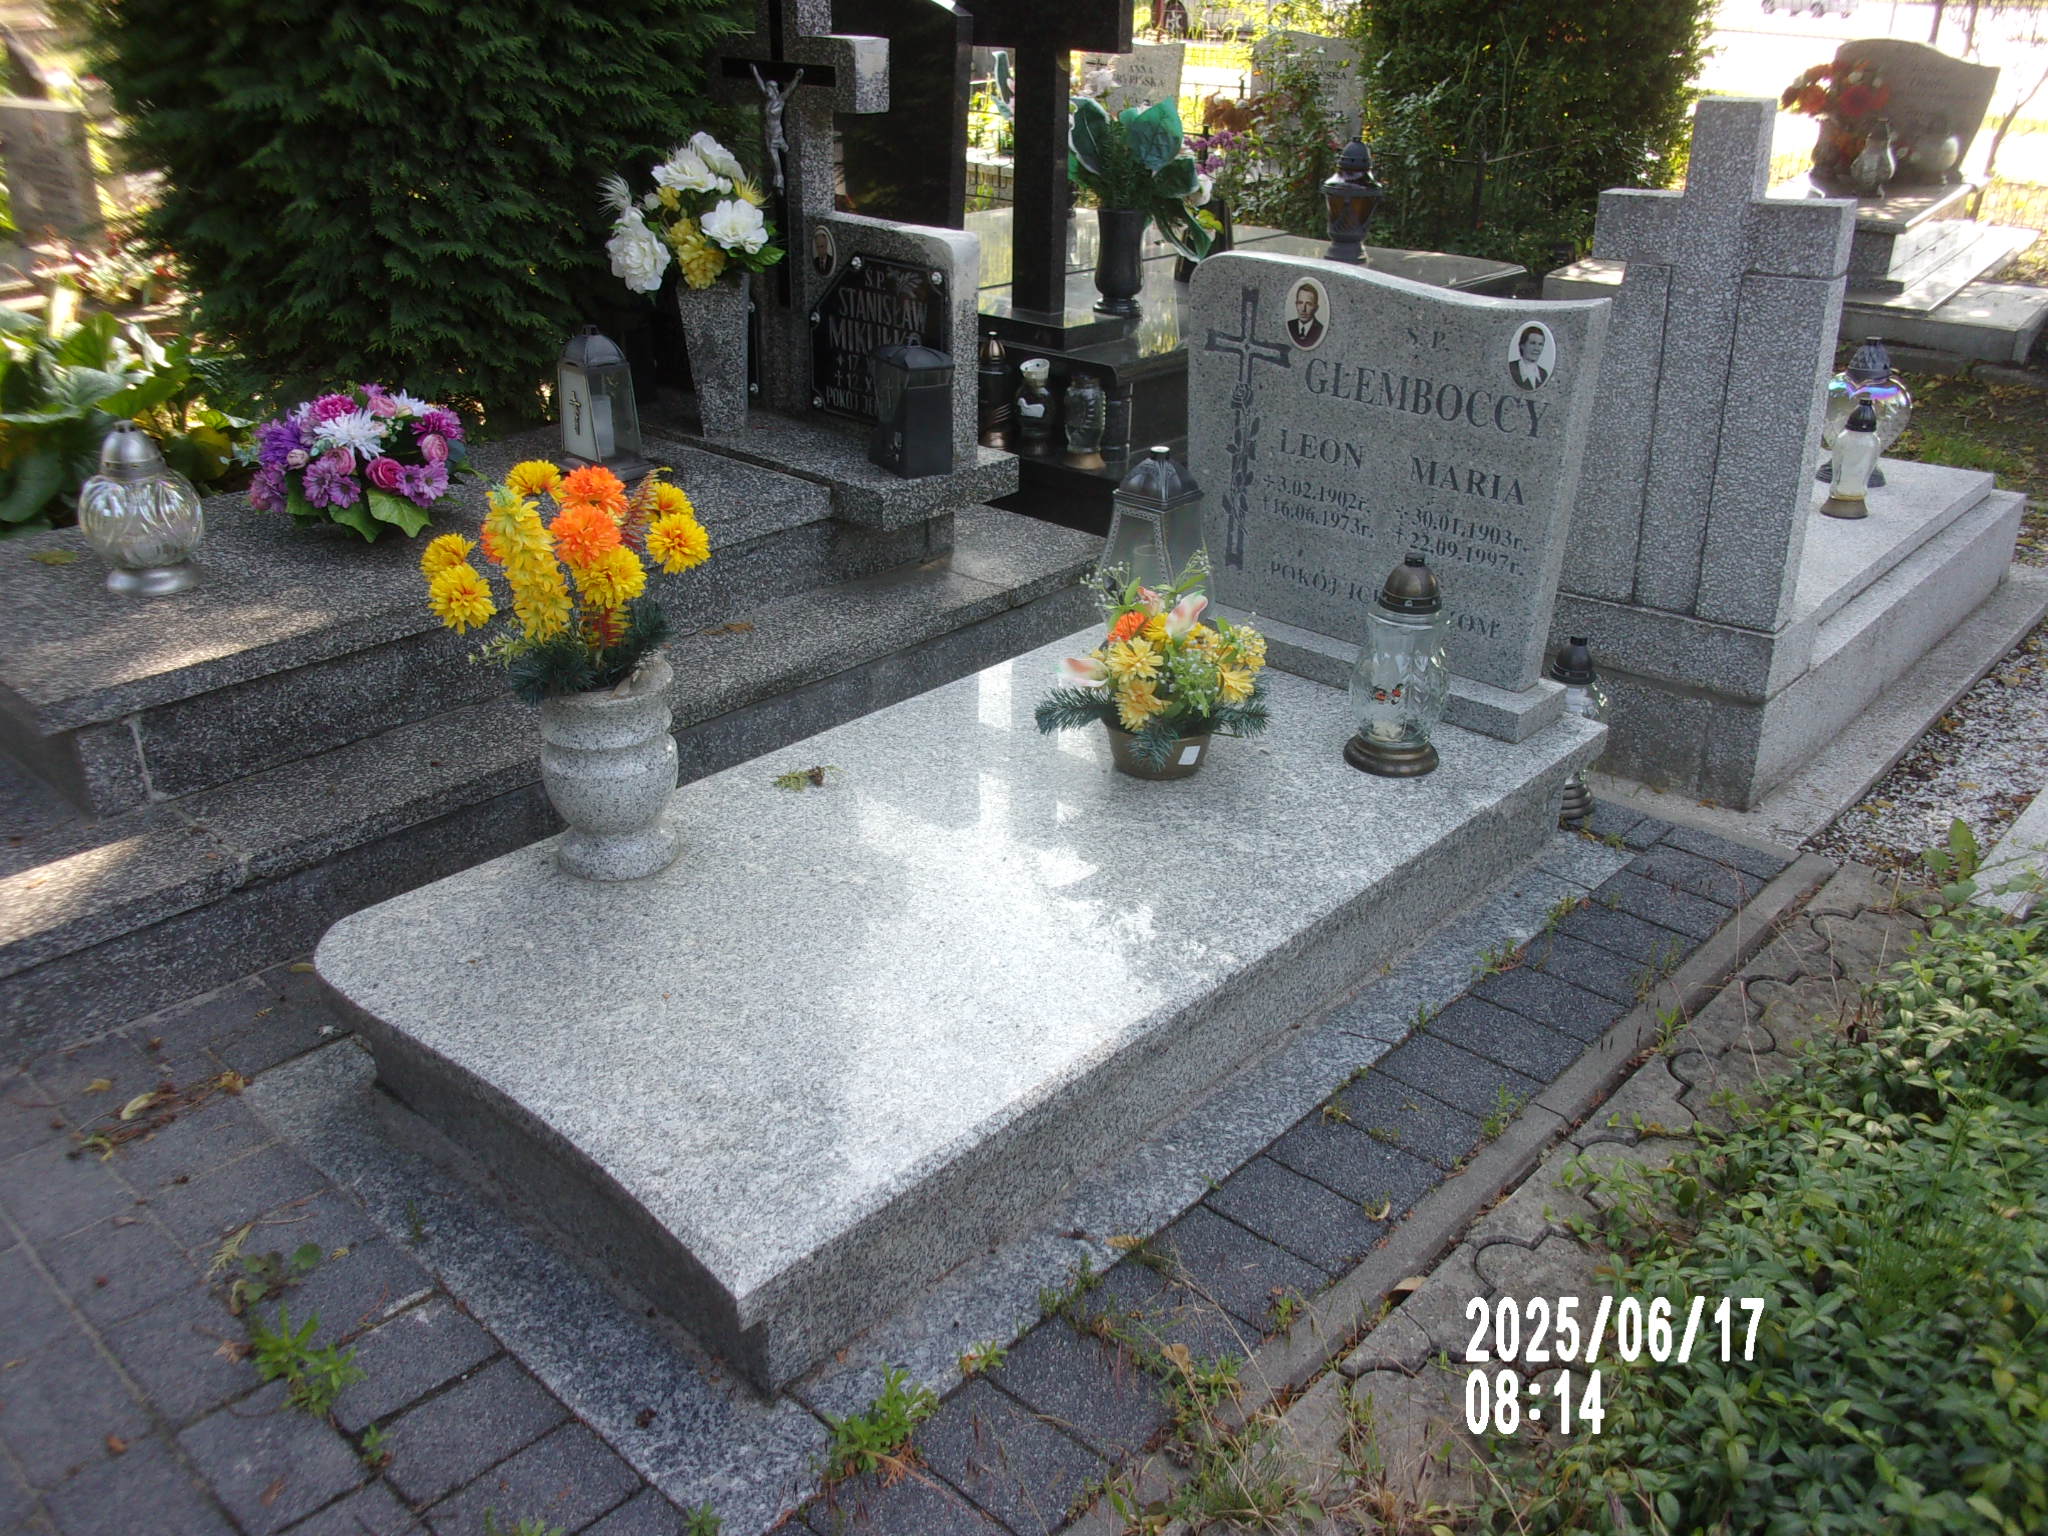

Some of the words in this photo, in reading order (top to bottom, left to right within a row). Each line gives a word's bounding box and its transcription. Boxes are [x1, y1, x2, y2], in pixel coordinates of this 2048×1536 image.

[839, 287, 928, 335] STANISŁAW
[1279, 429, 1367, 470] LEON
[1411, 456, 1526, 507] MARIA
